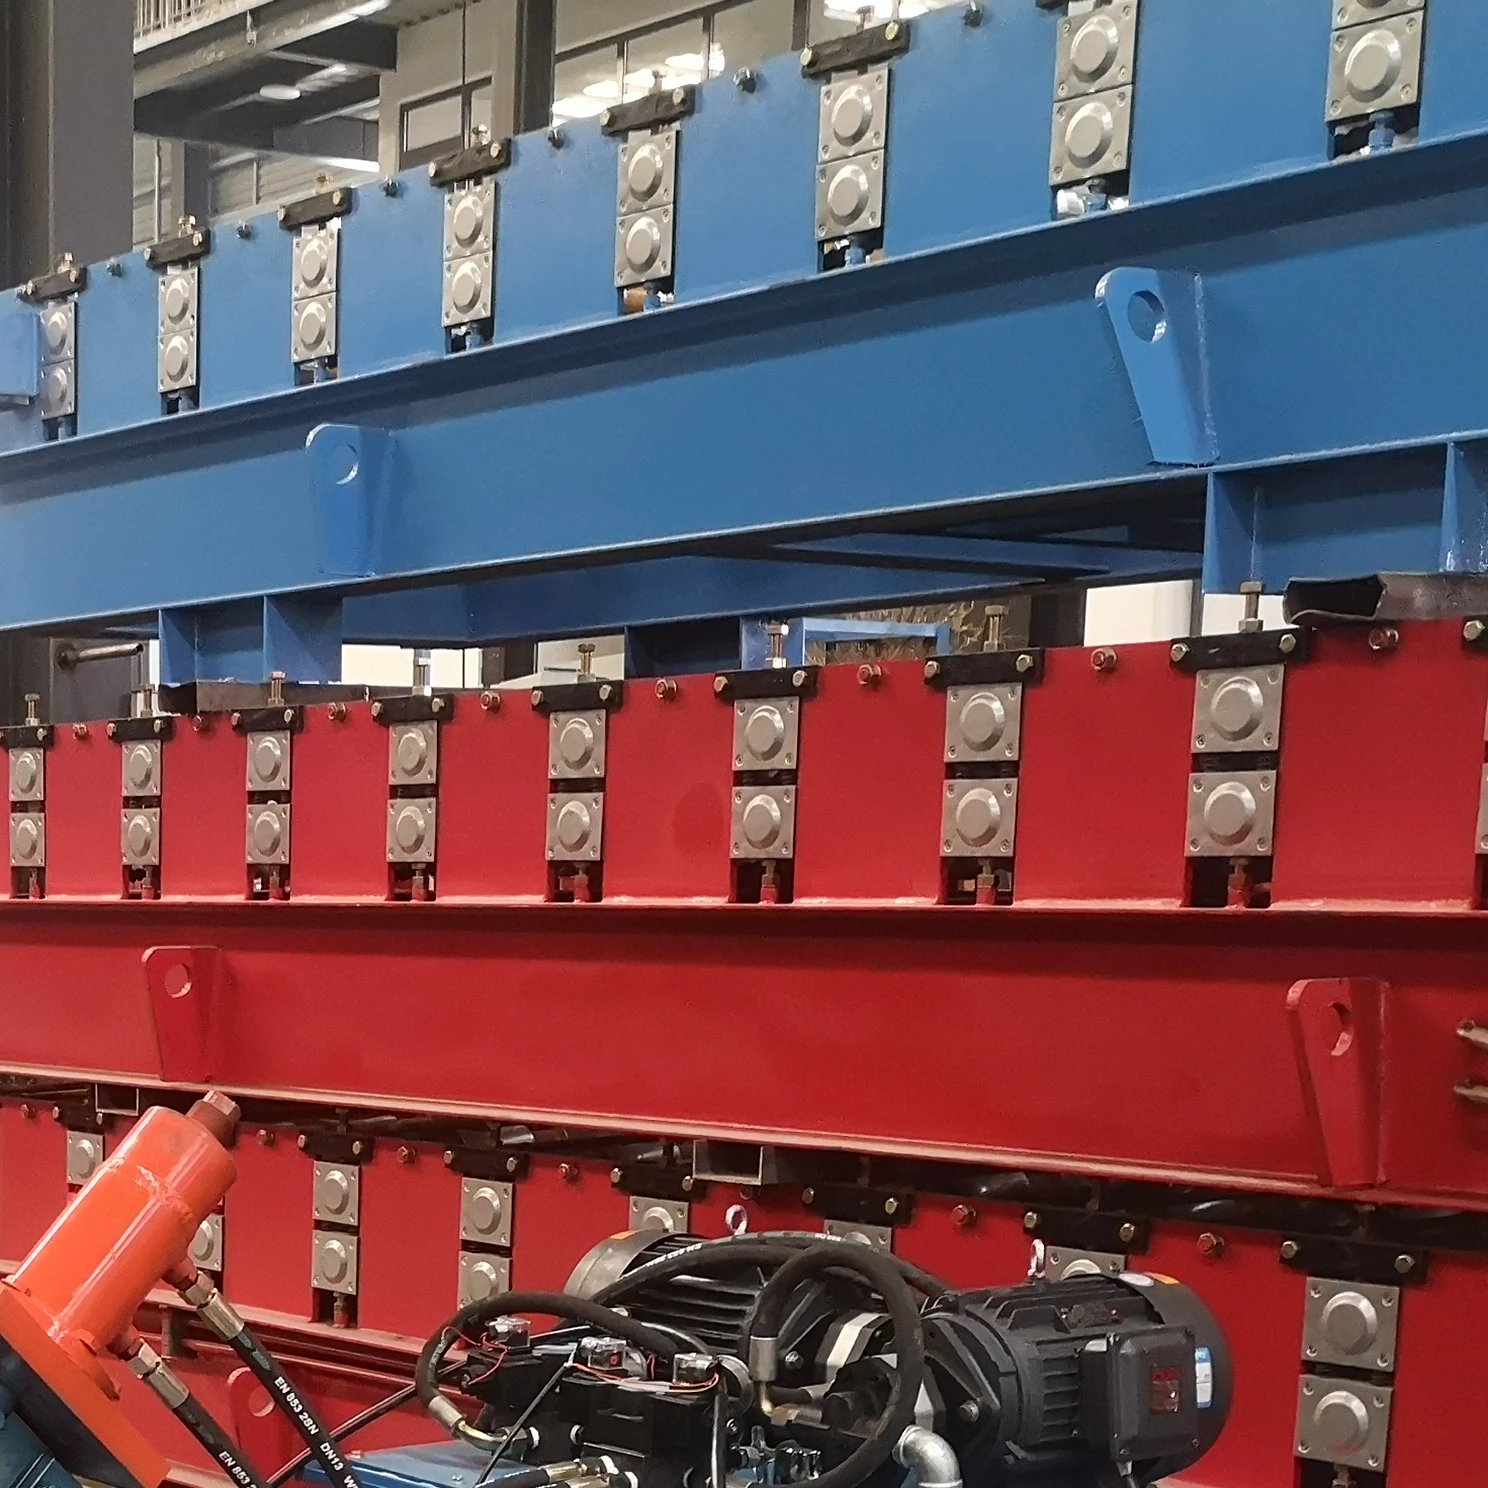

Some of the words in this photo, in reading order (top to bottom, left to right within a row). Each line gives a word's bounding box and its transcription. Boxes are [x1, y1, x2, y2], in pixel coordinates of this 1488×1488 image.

[274, 1376, 291, 1394] EN
[286, 1393, 303, 1413] 853
[298, 1409, 320, 1435] 2SN
[319, 1442, 344, 1471] DN13
[218, 1451, 236, 1468] EN
[231, 1464, 251, 1484] 853
